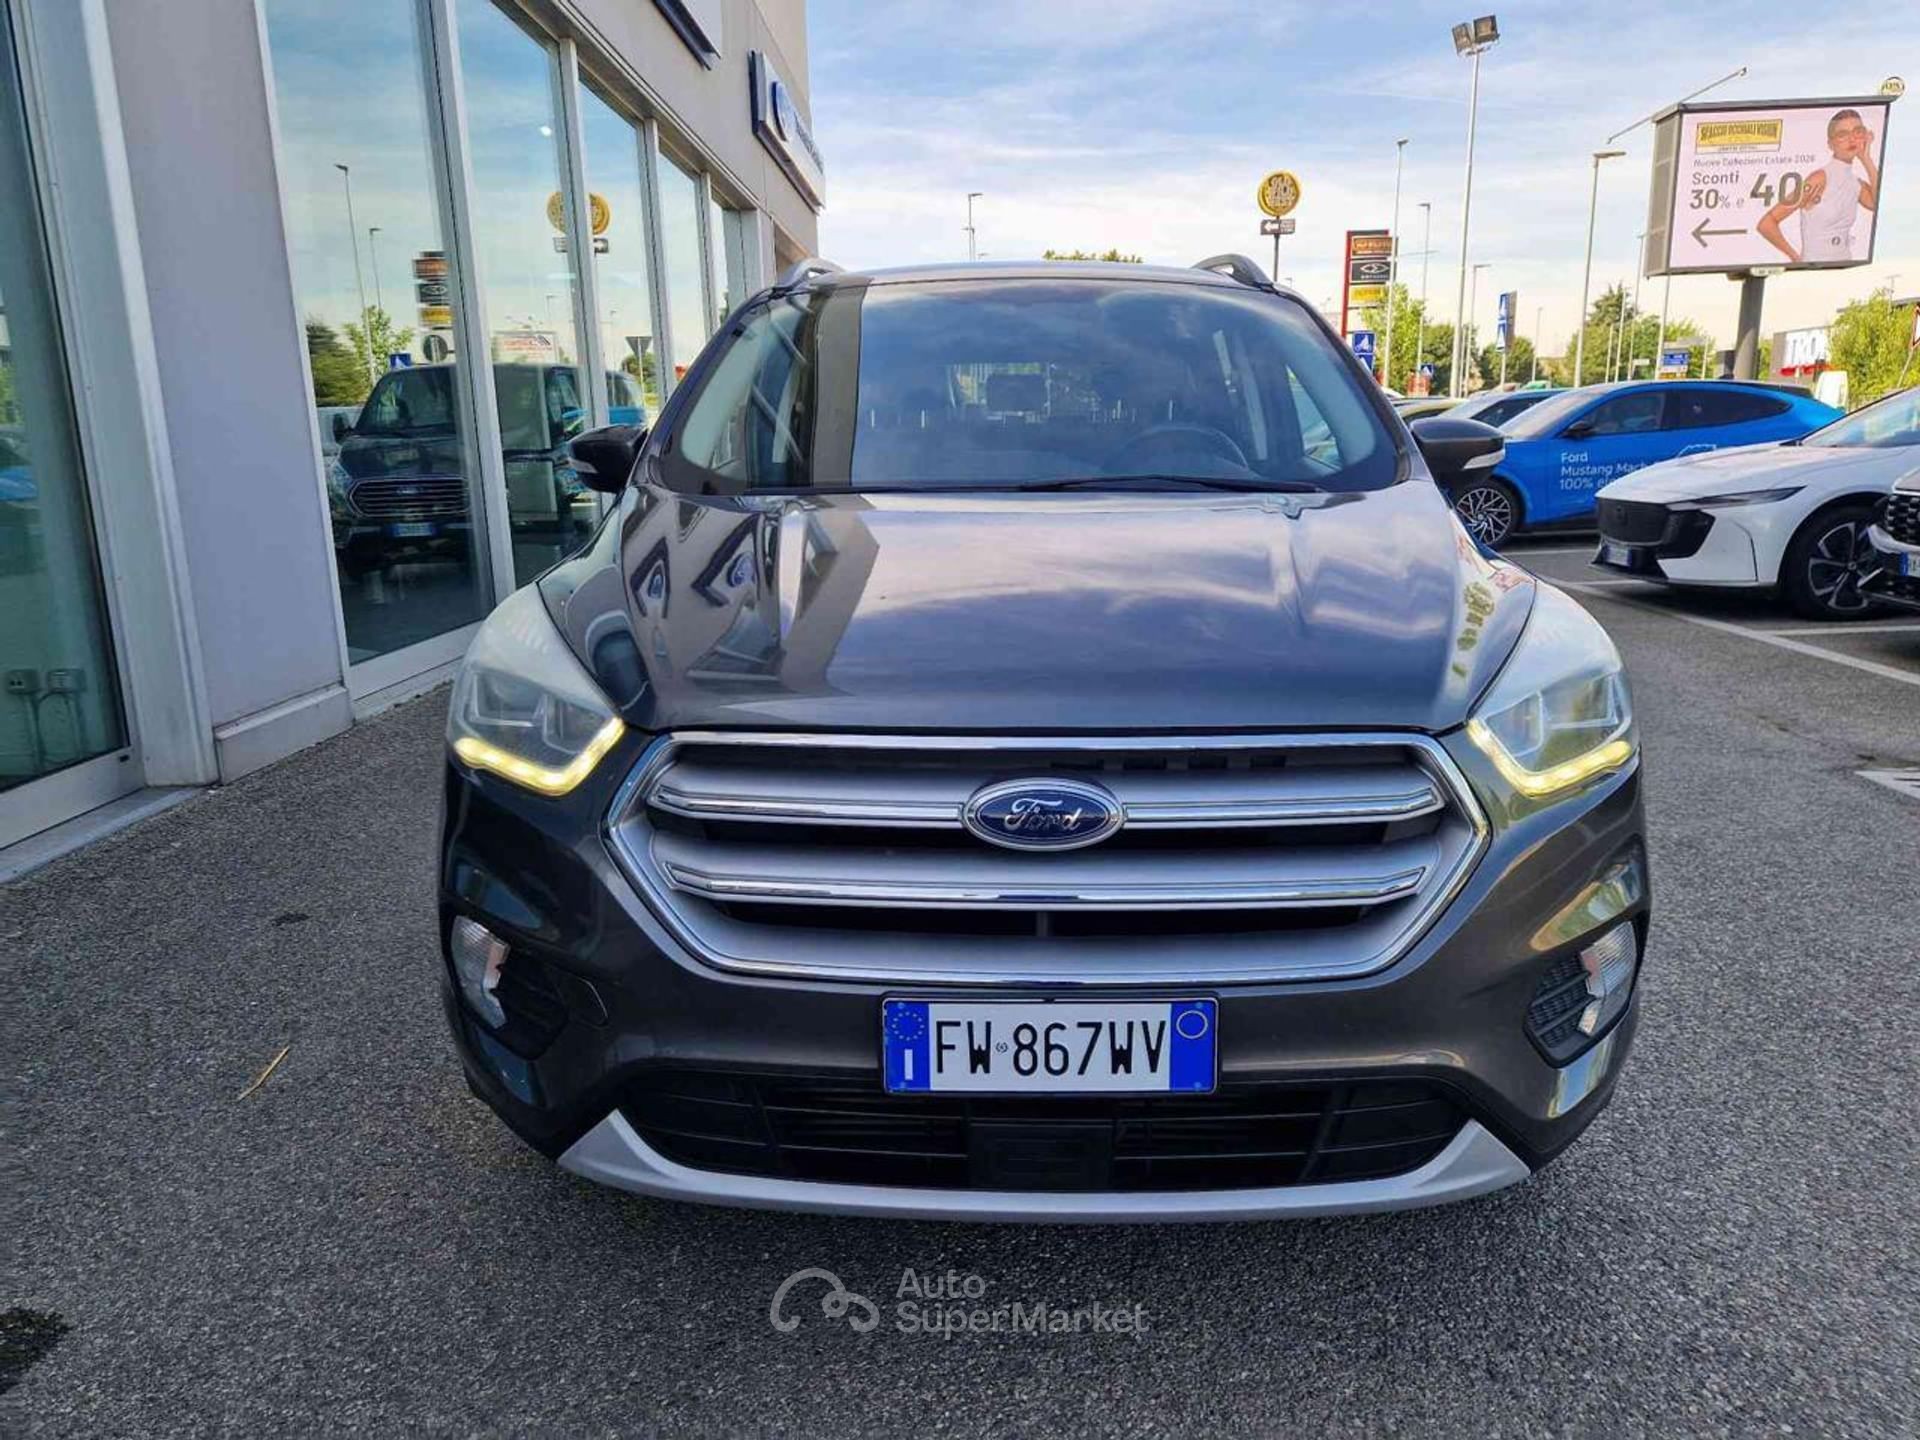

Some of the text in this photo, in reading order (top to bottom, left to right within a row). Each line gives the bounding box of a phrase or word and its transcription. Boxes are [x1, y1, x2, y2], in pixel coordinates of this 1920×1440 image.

[1692, 170, 1740, 185] Sconti
[1690, 188, 1730, 209] 30%
[1560, 452, 1588, 463] Ford
[1560, 464, 1613, 477] Mustang
[1560, 478, 1593, 490] 100%
[1004, 798, 1083, 831] Ford
